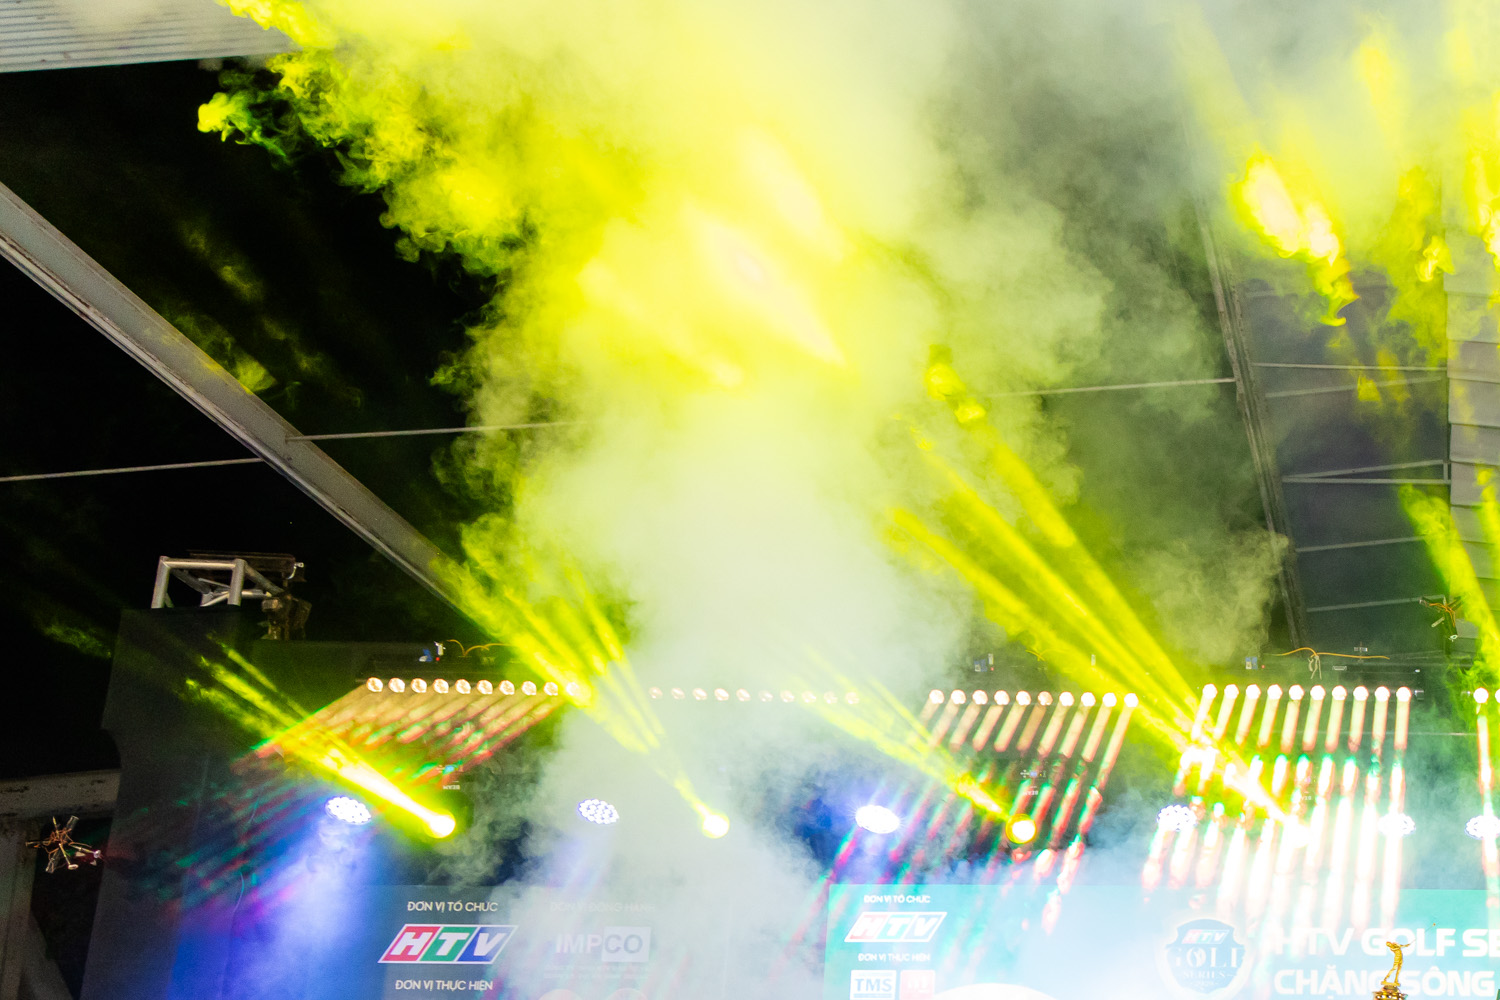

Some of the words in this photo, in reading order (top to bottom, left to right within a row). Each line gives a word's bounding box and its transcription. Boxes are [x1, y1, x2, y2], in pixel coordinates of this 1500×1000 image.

[407, 901, 433, 911] ĐƠN
[435, 902, 445, 913] VỊ
[850, 915, 941, 938] HTV
[1183, 930, 1228, 943] HTV
[387, 930, 510, 958] HTV
[555, 934, 644, 954] IMPCO
[1275, 928, 1354, 957] HTV
[1361, 928, 1456, 957] GOLF
[395, 980, 421, 990] ĐƠN
[424, 980, 434, 991] VỊ
[855, 978, 892, 992] TMS
[1404, 967, 1495, 997] SÔNG
